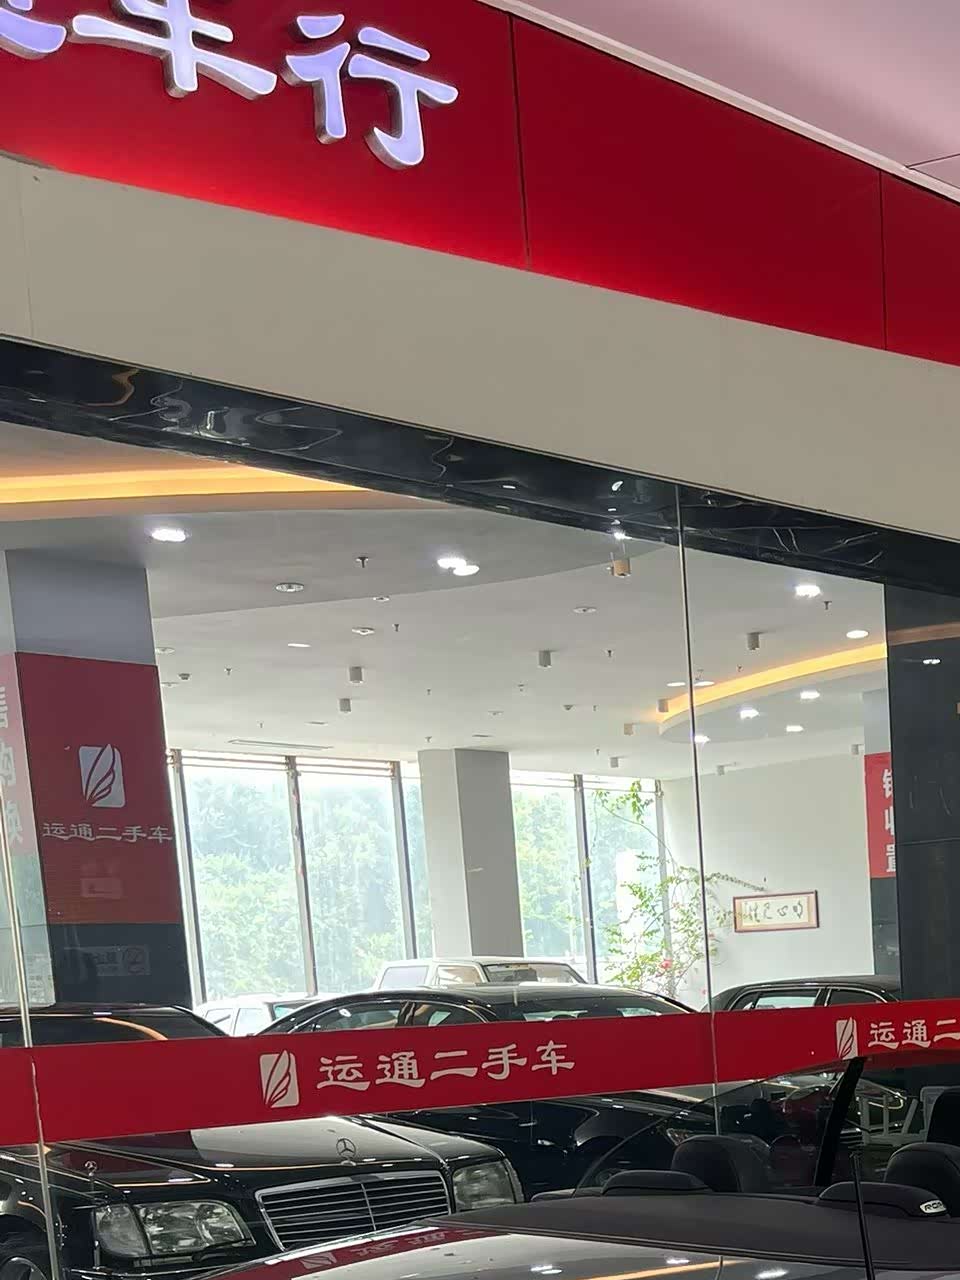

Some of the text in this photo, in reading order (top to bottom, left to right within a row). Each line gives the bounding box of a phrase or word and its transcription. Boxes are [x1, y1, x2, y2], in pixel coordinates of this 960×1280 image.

[0, 0, 459, 169] 车行
[41, 821, 174, 844] 运通二手车
[315, 1039, 576, 1092] 运通二手车
